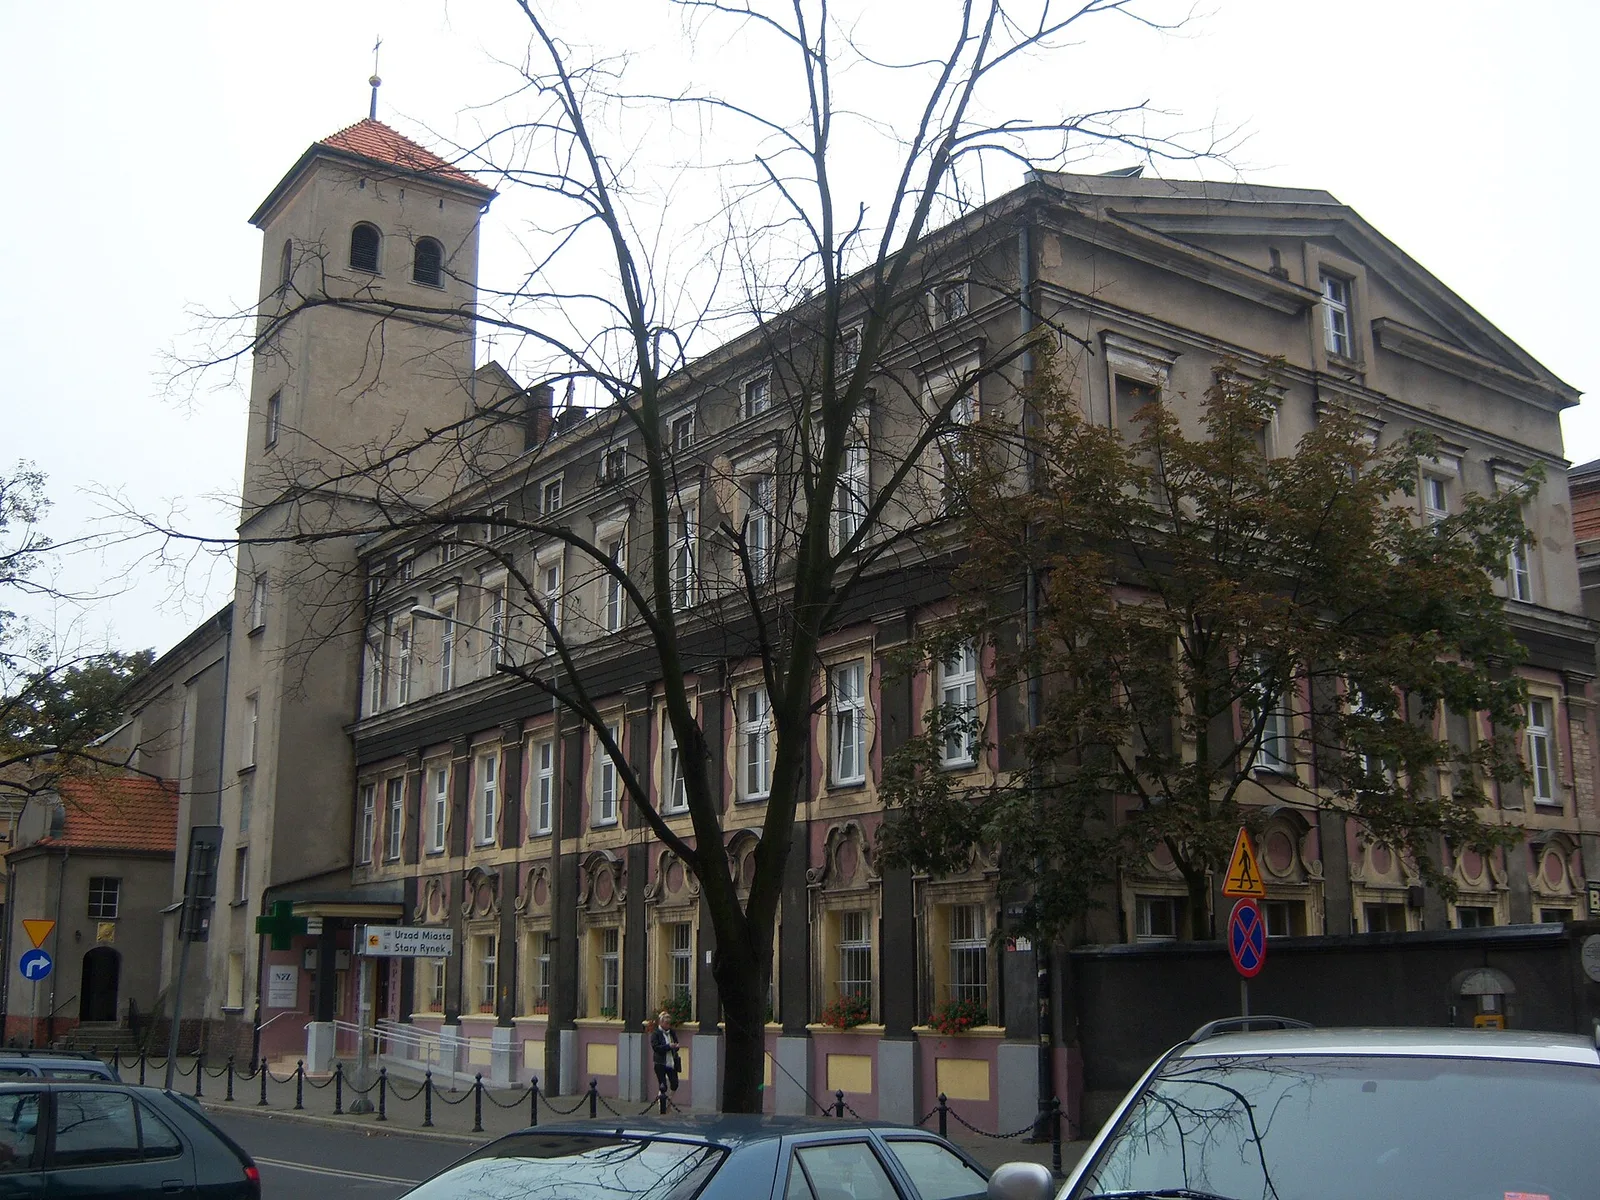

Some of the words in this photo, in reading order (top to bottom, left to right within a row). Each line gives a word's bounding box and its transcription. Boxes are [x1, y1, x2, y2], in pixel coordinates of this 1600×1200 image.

[394, 930, 419, 941] Urząd
[422, 931, 452, 941] Miasta
[394, 943, 417, 954] Stary
[420, 943, 446, 955] Rynek
